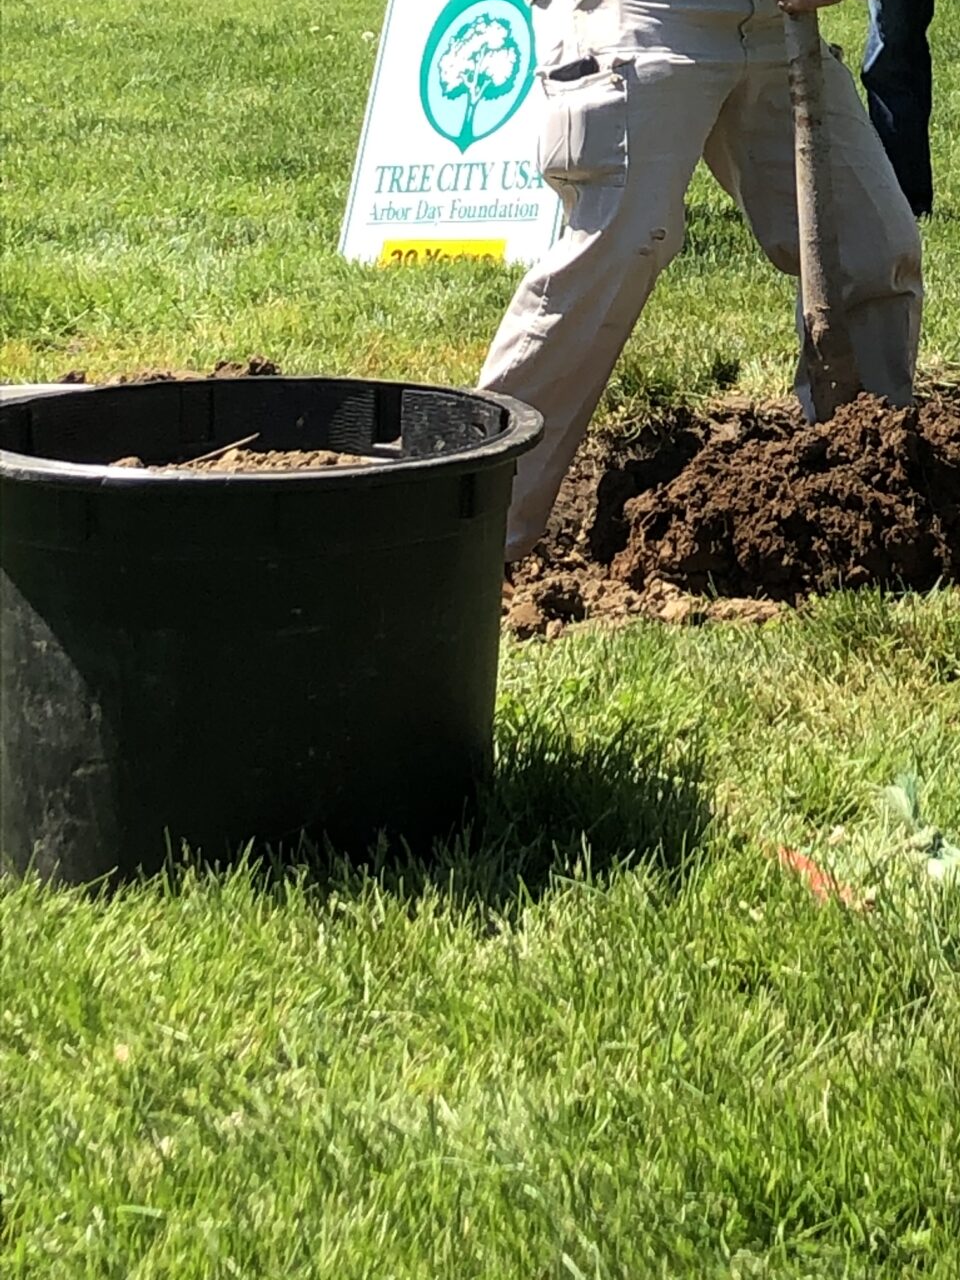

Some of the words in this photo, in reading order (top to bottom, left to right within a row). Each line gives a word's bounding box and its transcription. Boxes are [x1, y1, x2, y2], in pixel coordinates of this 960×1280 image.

[374, 164, 434, 193] TREE
[437, 162, 494, 192] CITY
[501, 160, 544, 190] USA
[369, 200, 412, 221] Arbor
[449, 197, 539, 219] Foundation
